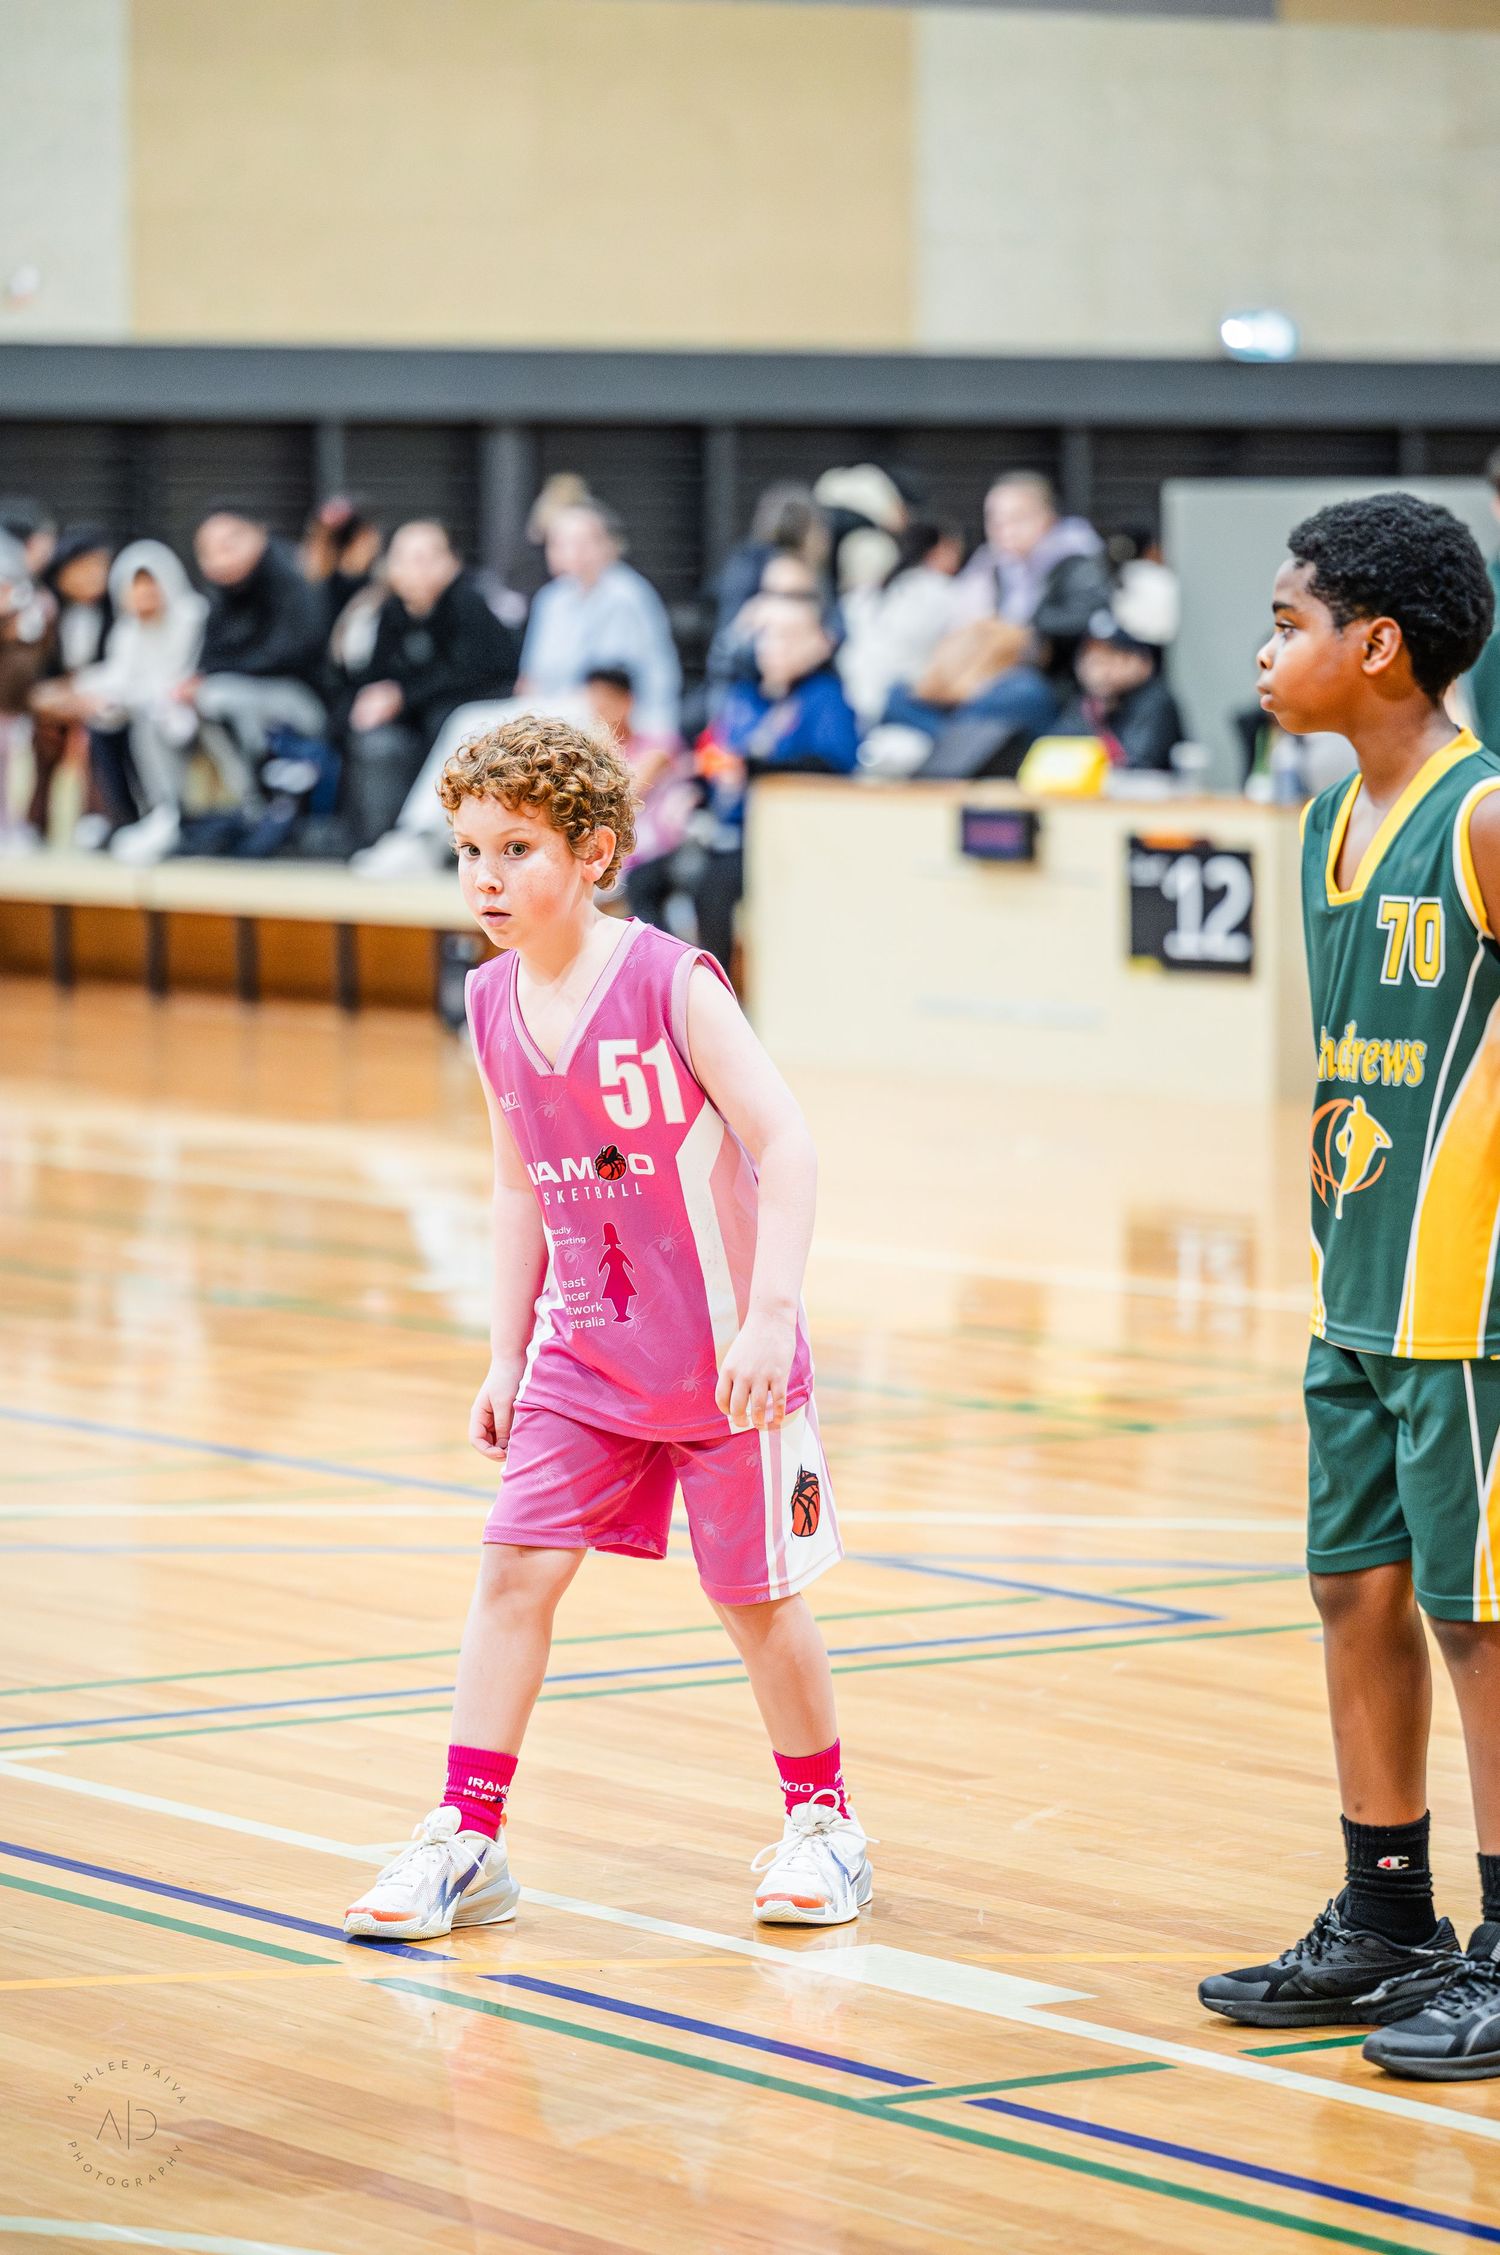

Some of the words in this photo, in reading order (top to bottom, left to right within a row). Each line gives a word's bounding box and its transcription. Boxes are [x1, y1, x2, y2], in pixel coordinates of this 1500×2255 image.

[1161, 854, 1252, 962] 12
[1376, 895, 1446, 987] 70
[598, 1038, 687, 1130] 51
[543, 1182, 643, 1206] SKETBALL
[562, 1276, 587, 1289] east
[564, 1291, 591, 1302] ncer
[566, 1301, 603, 1316] twork
[570, 1316, 606, 1330] stralia
